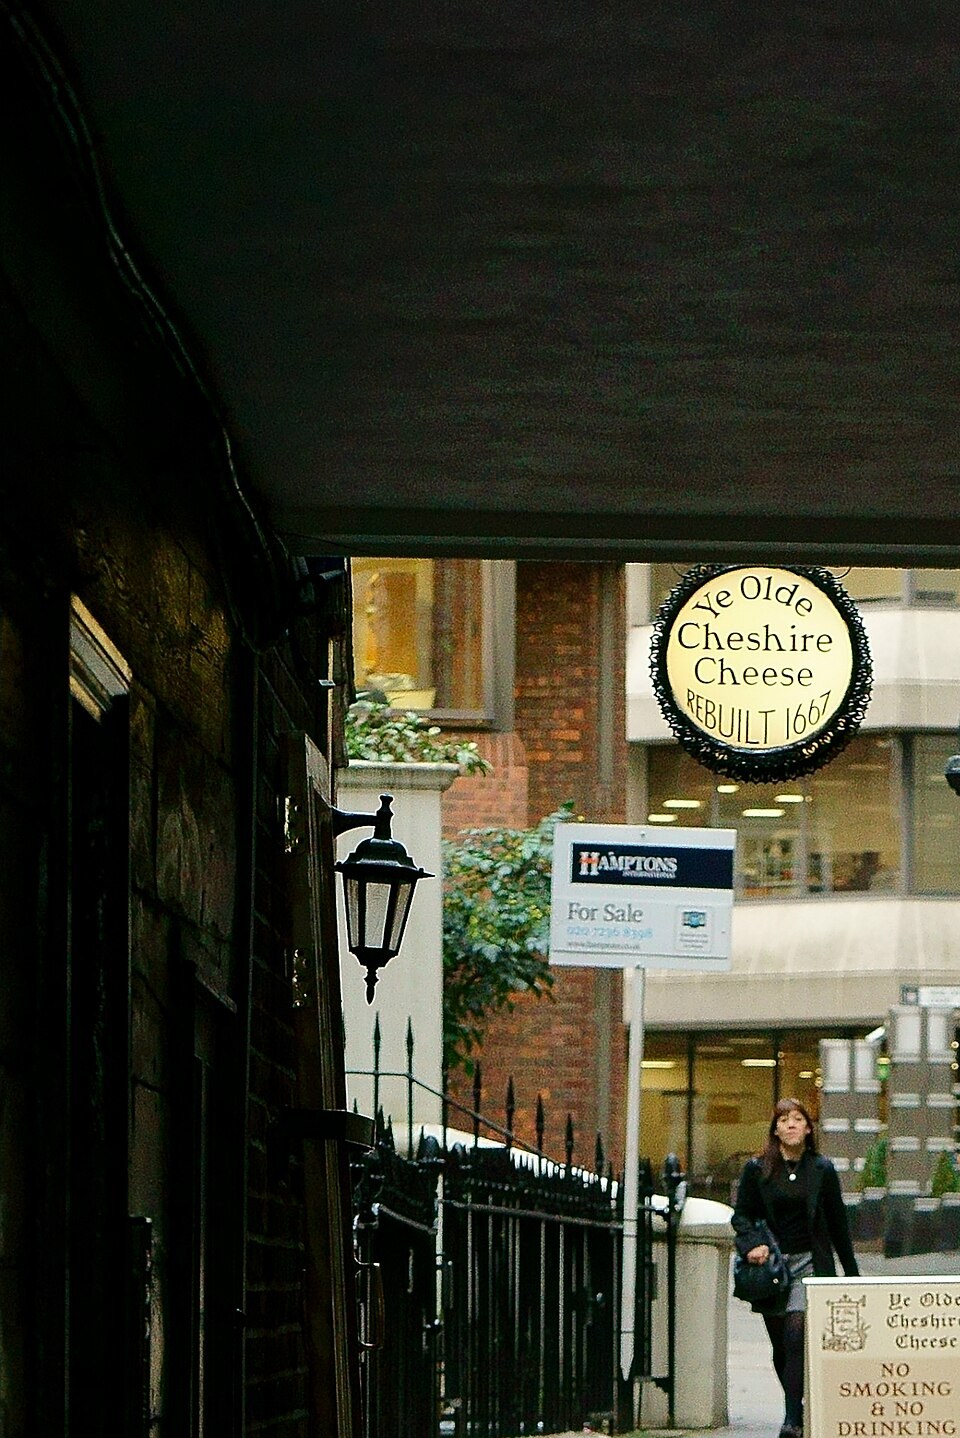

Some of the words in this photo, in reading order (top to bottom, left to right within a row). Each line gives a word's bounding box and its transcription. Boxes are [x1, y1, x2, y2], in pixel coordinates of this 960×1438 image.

[692, 589, 734, 619] Ye
[740, 575, 813, 617] Olde
[677, 622, 833, 653] Cheshire
[694, 656, 813, 687] Cheese
[686, 688, 776, 744] REBUILT
[786, 690, 831, 740] 1667
[579, 851, 678, 876] HAMPTONS
[568, 902, 598, 921] For
[603, 903, 643, 923] Sale
[888, 1293, 911, 1311] Ye
[895, 1333, 958, 1350] Cheese
[881, 1362, 910, 1378] NO
[838, 1381, 952, 1397] SMOKING
[870, 1401, 885, 1416] &
[895, 1401, 924, 1416] NO
[838, 1420, 957, 1437] DRINKING
